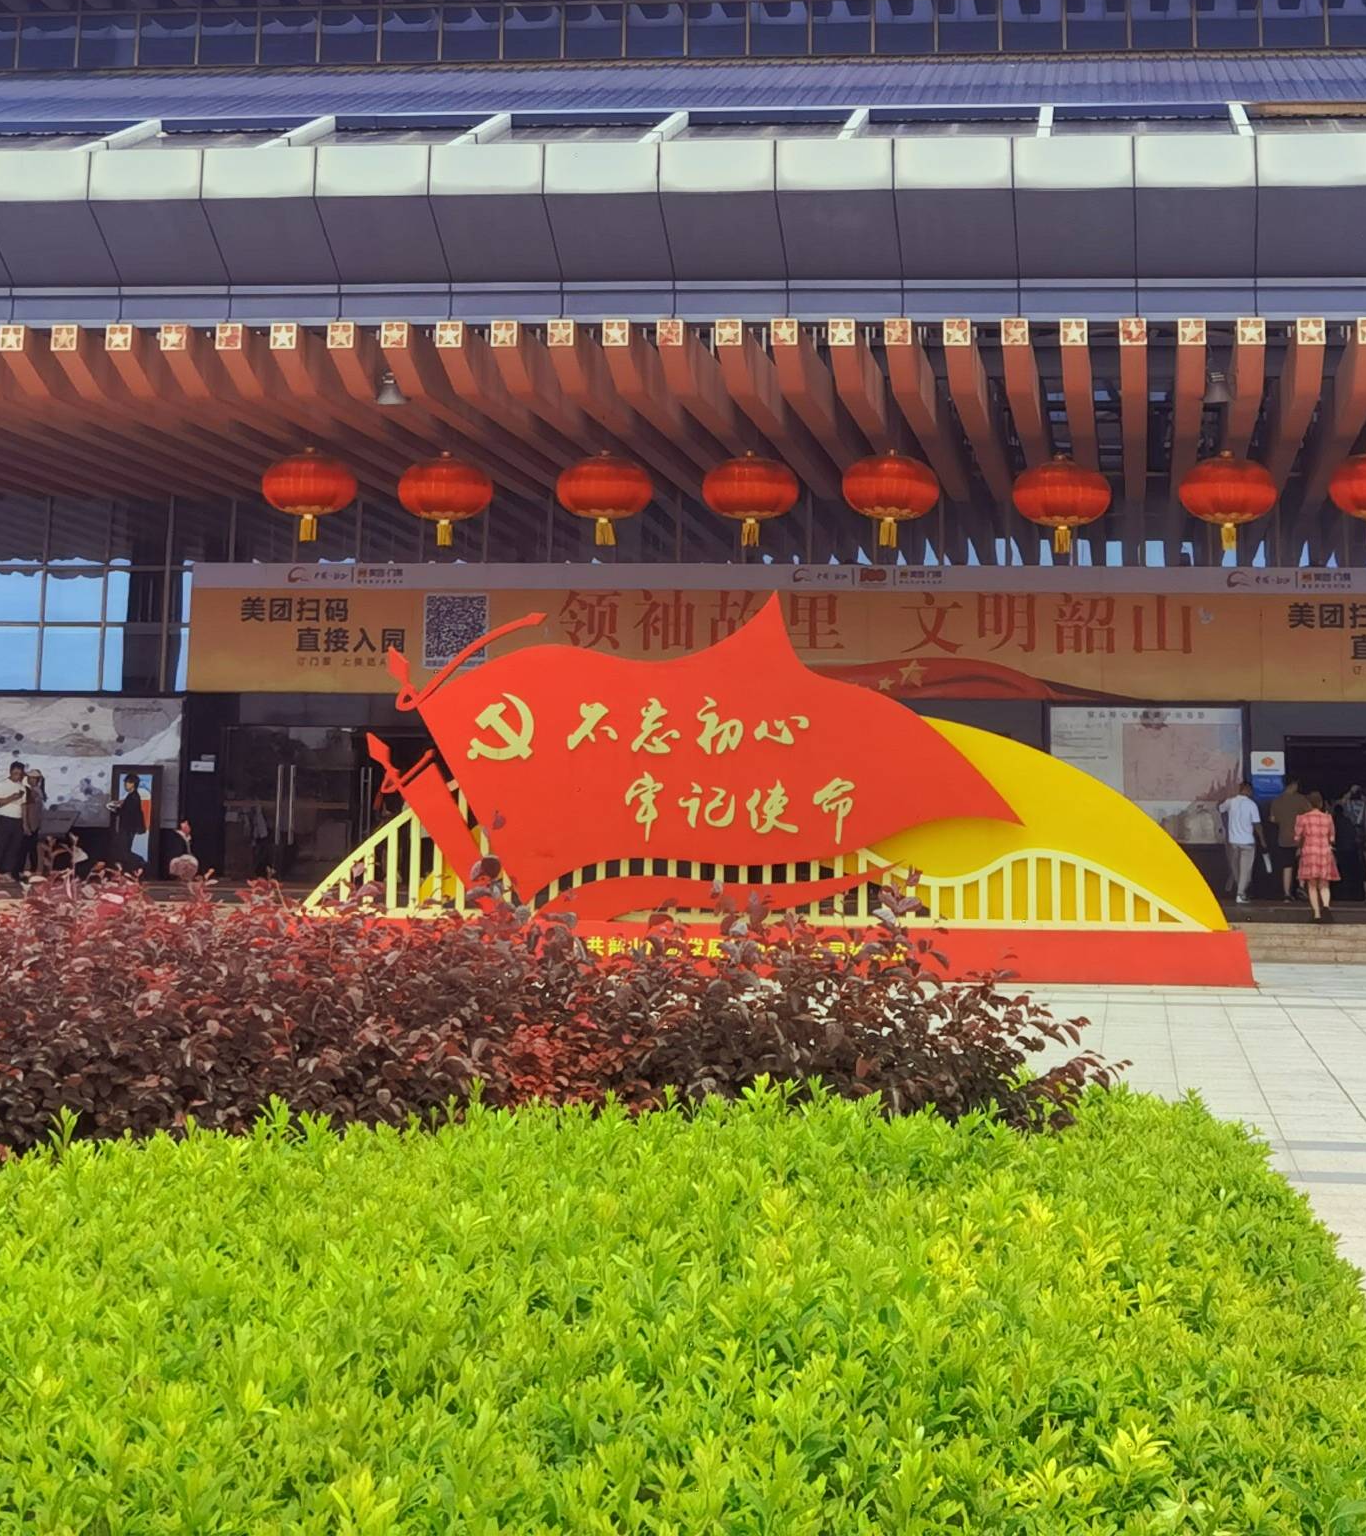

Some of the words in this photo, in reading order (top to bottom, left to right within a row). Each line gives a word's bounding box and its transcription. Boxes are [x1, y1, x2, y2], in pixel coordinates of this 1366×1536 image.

[241, 596, 349, 622] 美团扫码
[559, 589, 844, 651] 领袖故里
[900, 591, 1194, 656] 文明韶山
[296, 627, 405, 653] 直接入园
[567, 696, 810, 755] 不忘初心
[625, 771, 855, 845] 牢记使命
